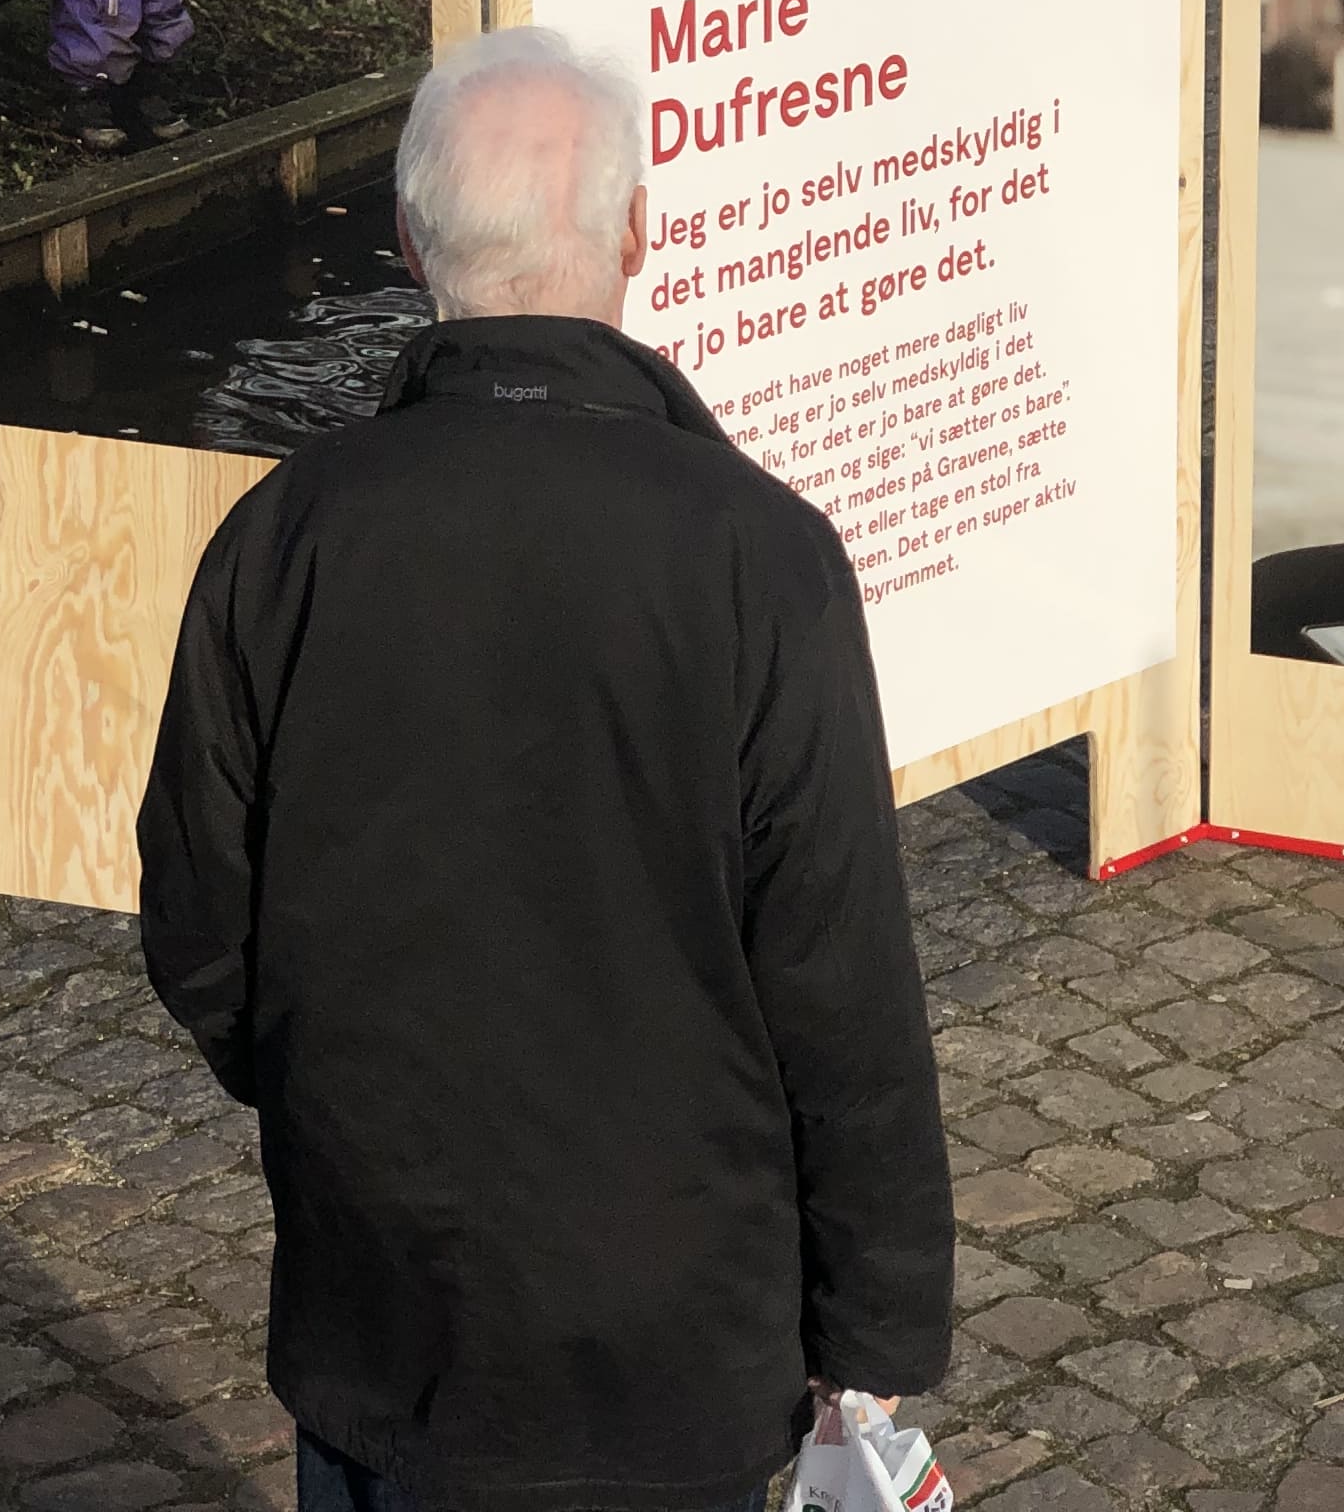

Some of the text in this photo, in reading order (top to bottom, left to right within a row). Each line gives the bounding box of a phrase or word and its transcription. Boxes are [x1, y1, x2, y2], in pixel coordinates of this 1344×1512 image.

[651, 54, 908, 167] Dufresne
[650, 97, 1060, 251] Jeg er jo selv medskyldig i
[651, 162, 1050, 312] det manglende liv, for det
[692, 321, 725, 371] jo
[737, 302, 807, 347] bare
[818, 281, 850, 321] at
[860, 264, 927, 317] gøre
[937, 238, 995, 283] det.
[741, 379, 784, 416] godt
[789, 367, 833, 395] have
[838, 345, 890, 379] noget
[895, 332, 940, 361] mere
[945, 308, 1004, 344] dagligt
[1009, 301, 1028, 324] liv
[768, 410, 800, 436] Jeg
[805, 403, 825, 423] er
[827, 393, 846, 423] jo
[851, 380, 887, 408] selv
[892, 346, 990, 395] medskyldig
[995, 339, 1001, 361] i
[1005, 331, 1034, 357] det
[790, 439, 818, 462] for
[822, 424, 853, 451] det
[857, 423, 875, 441] er
[879, 411, 899, 439] jo
[903, 398, 943, 425] bare
[947, 386, 966, 409] at
[971, 375, 1009, 407] gøre
[1013, 360, 1047, 387] det.
[840, 457, 862, 480] og
[867, 443, 906, 470] sige:
[938, 411, 997, 445] sætter
[1001, 404, 1021, 423] os
[848, 476, 906, 510] mødes
[911, 461, 934, 493] på
[937, 440, 1013, 478] Gravene,
[1017, 419, 1067, 450] sætte
[868, 508, 907, 535] eller
[910, 494, 949, 520] tage
[954, 484, 976, 505] en
[980, 465, 1011, 496] stol
[1015, 461, 1042, 483] fra
[898, 530, 929, 559] Det
[934, 525, 953, 545] er
[956, 516, 978, 536] en
[982, 496, 1031, 527] super
[1034, 477, 1077, 508] aktiv
[862, 553, 960, 606] byrummet.
